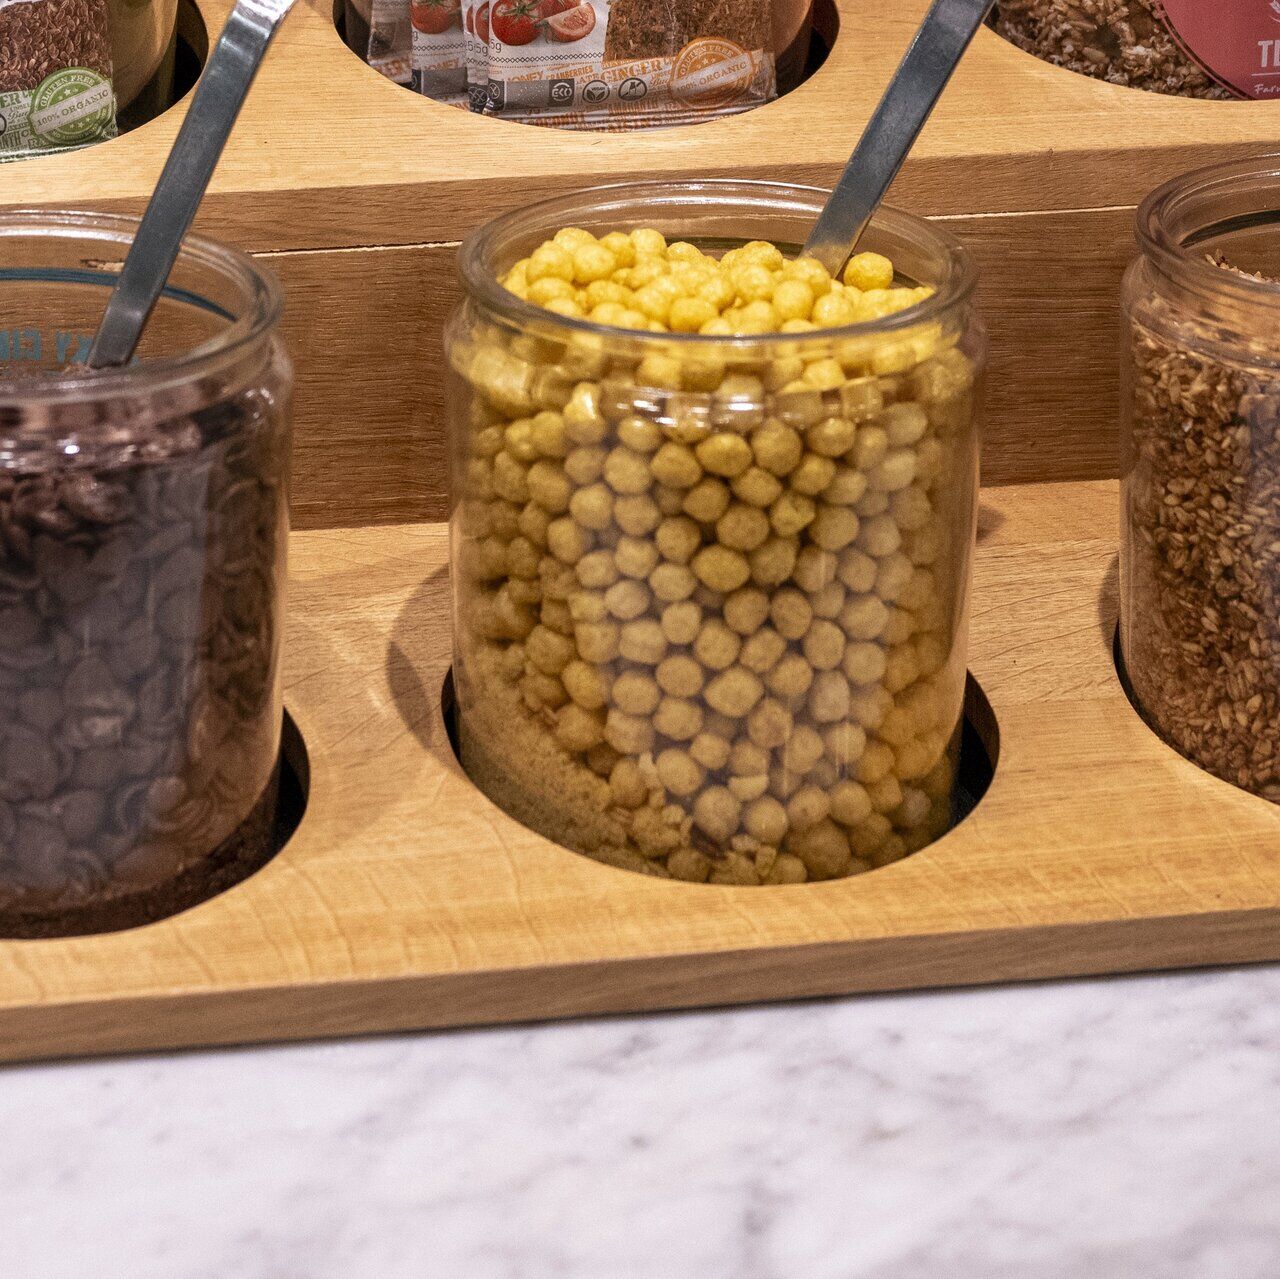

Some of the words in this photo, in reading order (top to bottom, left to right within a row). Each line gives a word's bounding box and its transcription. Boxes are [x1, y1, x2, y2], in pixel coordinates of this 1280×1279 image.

[710, 45, 734, 58] FREE
[546, 65, 594, 81] CRANBERRIES
[600, 59, 662, 81] GINGER
[699, 61, 747, 85] ORGANIC
[40, 77, 68, 107] GLUTEN
[70, 74, 95, 86] FREE
[37, 112, 60, 126] 100%
[61, 88, 109, 116] ORGANIC
